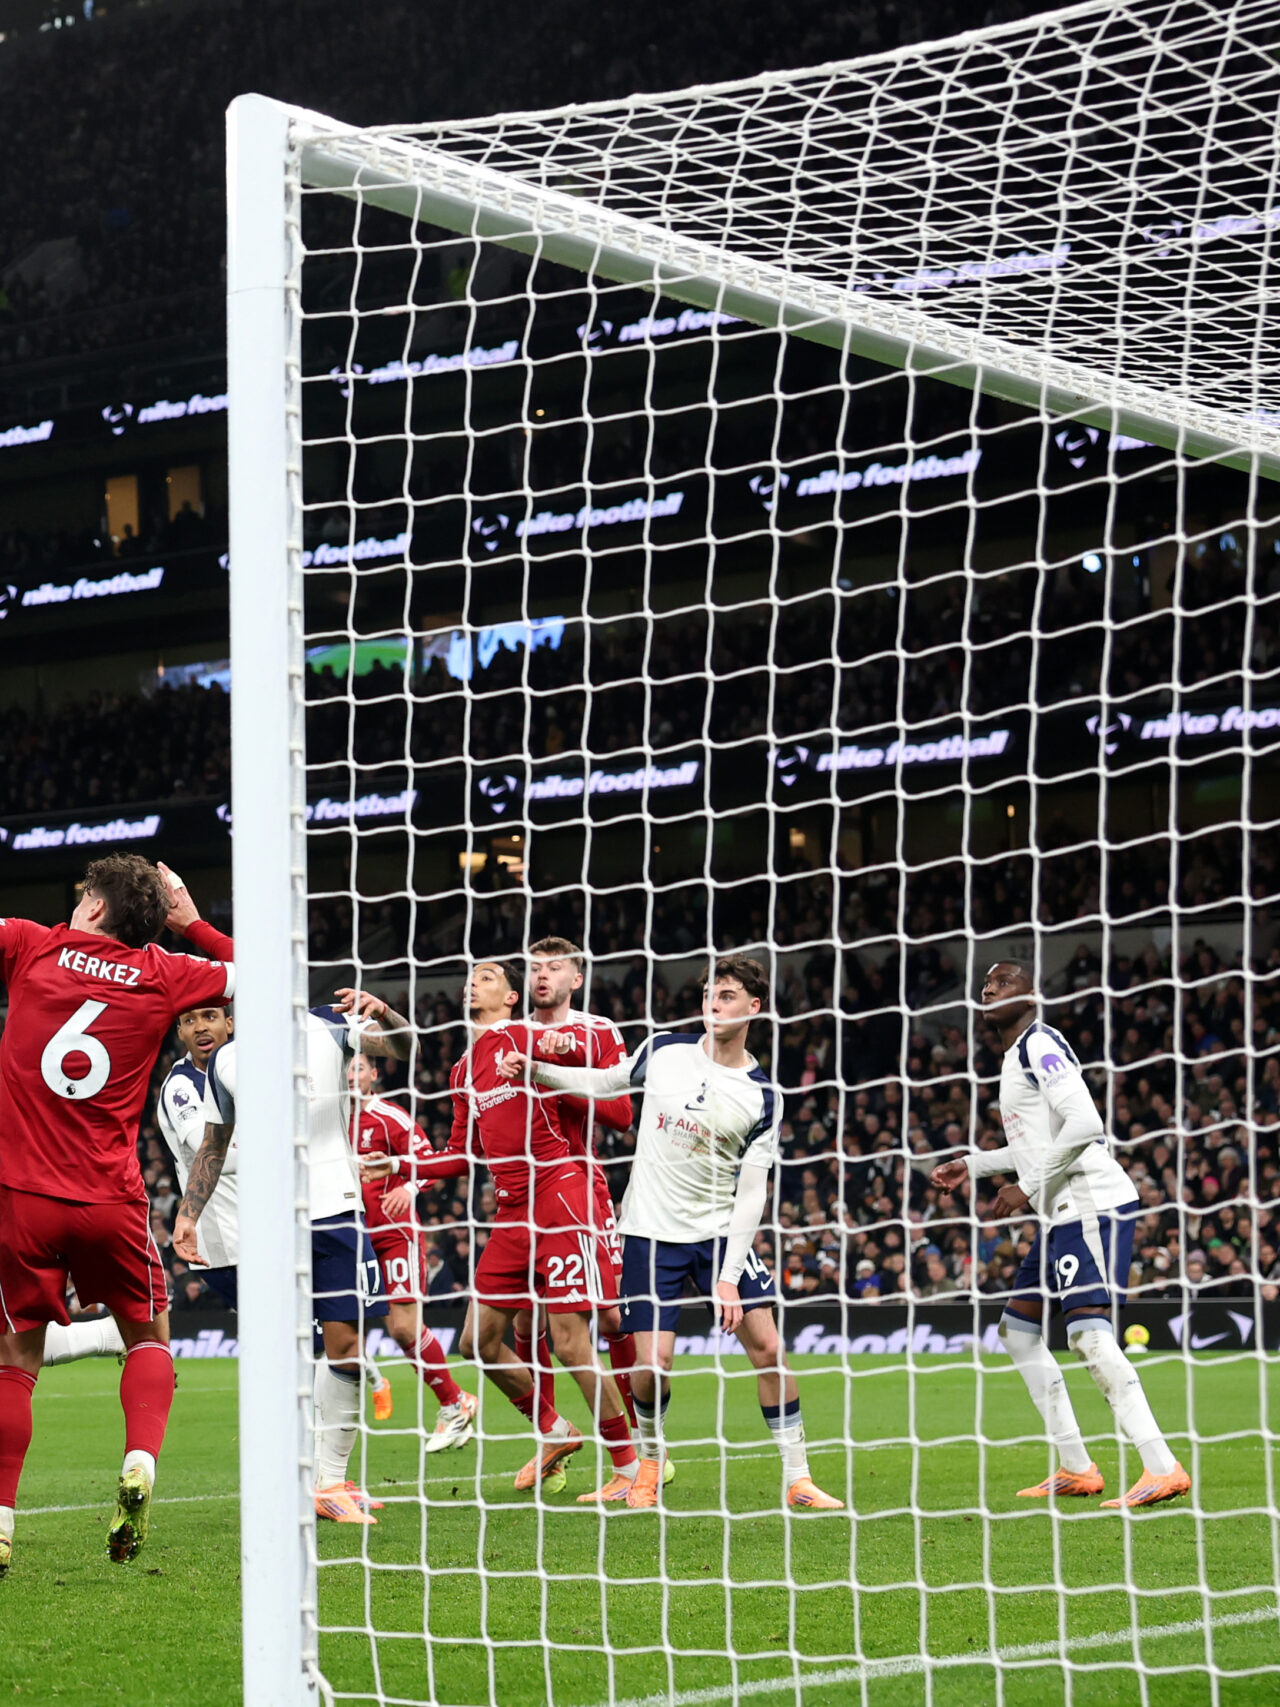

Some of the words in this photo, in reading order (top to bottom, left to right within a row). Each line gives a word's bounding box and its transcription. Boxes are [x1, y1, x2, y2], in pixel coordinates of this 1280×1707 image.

[619, 317, 677, 342] nike
[138, 400, 188, 424] nike
[796, 470, 863, 497] nike
[862, 449, 983, 488] football
[515, 512, 576, 538] nike
[575, 492, 685, 529] football
[22, 583, 72, 606] nike
[72, 568, 164, 599] football
[1140, 711, 1220, 740] nike
[816, 746, 885, 773] nike
[884, 730, 1010, 766] football
[523, 775, 585, 801] nike
[586, 761, 699, 794] football
[13, 827, 62, 849] nike
[62, 815, 160, 845] football
[57, 947, 142, 987] KERKEZ
[40, 999, 111, 1100] 6
[675, 1118, 699, 1135] AIA
[358, 1259, 380, 1297] 17
[385, 1257, 409, 1285] 10
[547, 1254, 584, 1288] 22
[744, 1247, 771, 1281] 14
